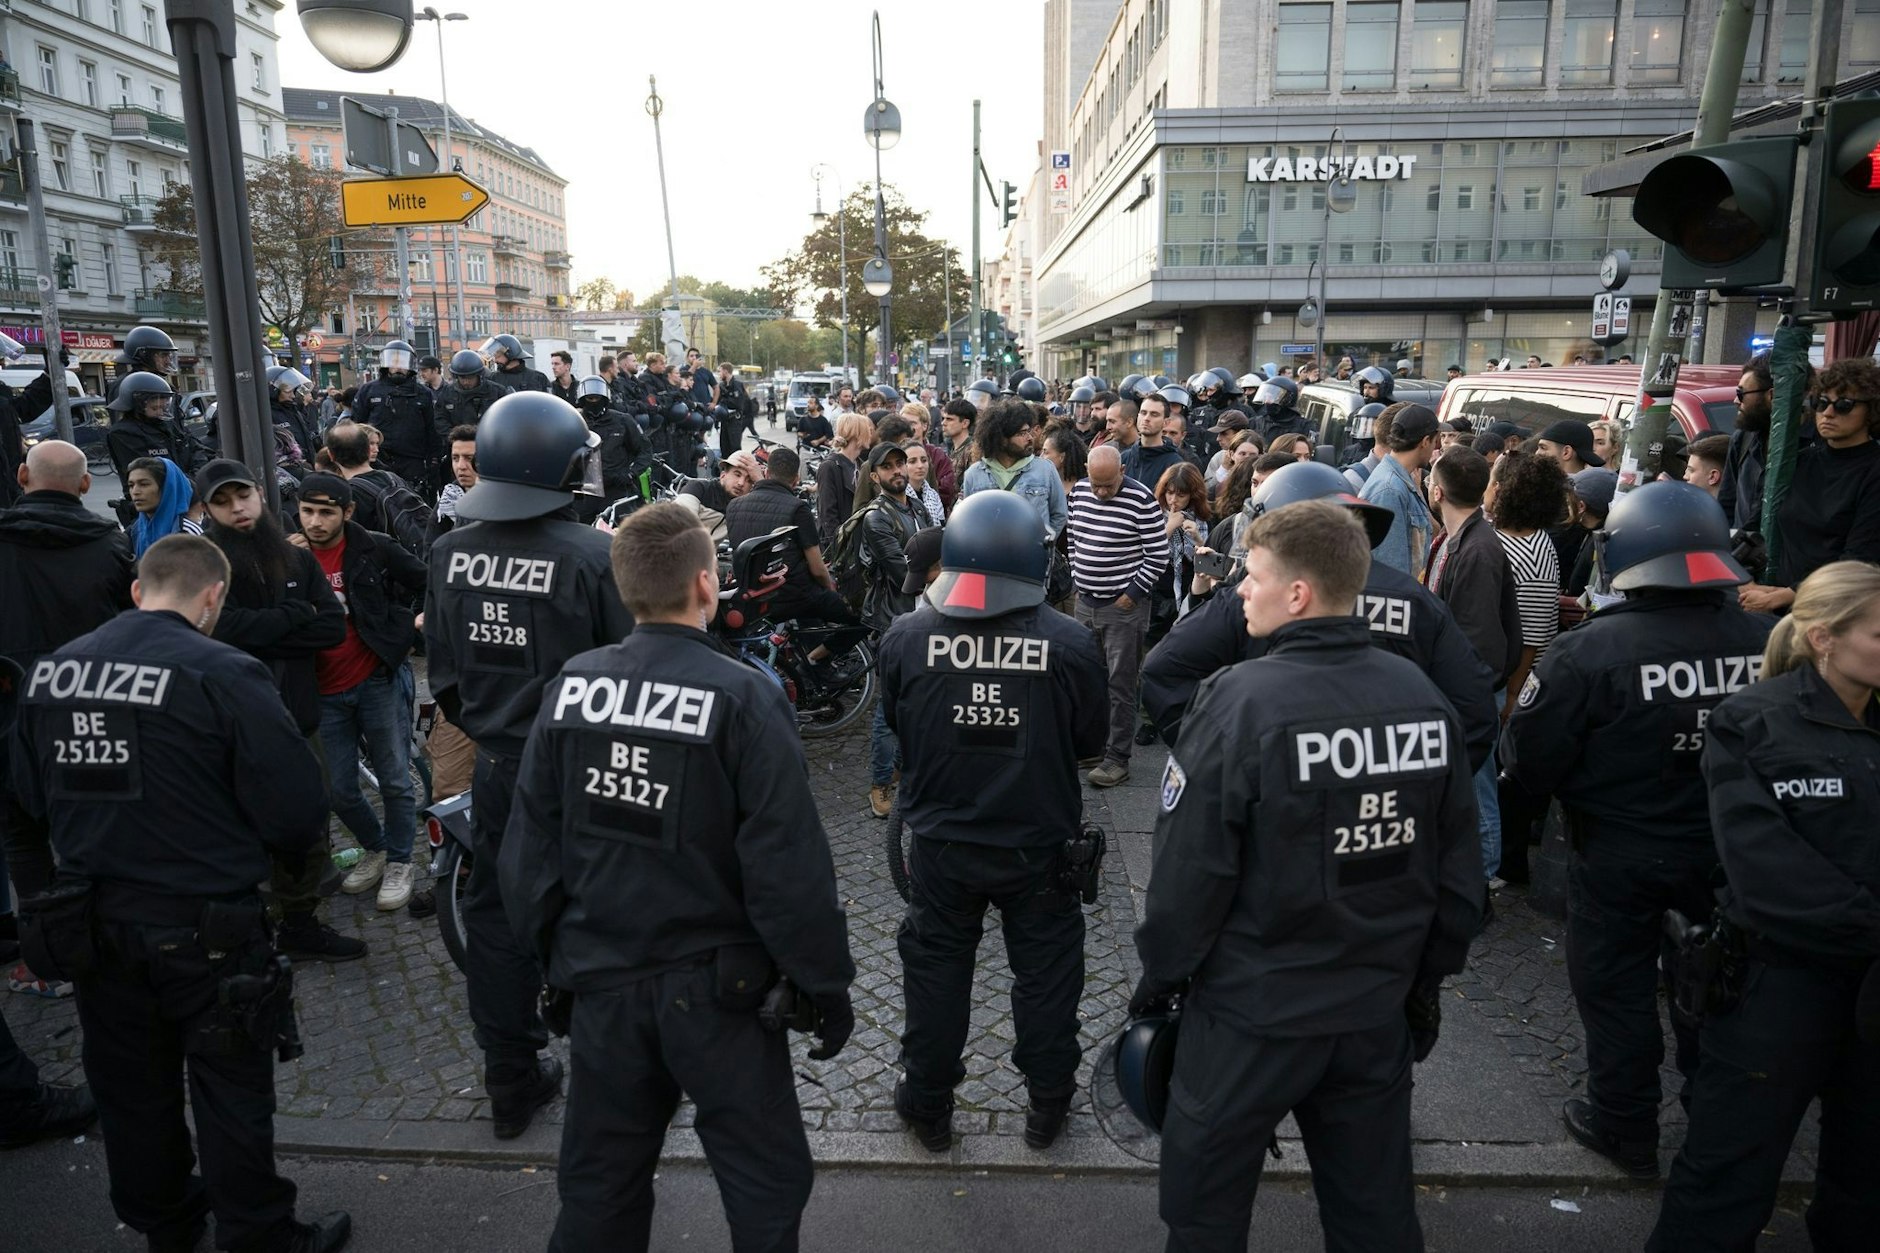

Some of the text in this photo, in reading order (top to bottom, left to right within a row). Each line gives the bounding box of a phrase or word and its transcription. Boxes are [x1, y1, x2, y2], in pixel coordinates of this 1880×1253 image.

[1247, 155, 1417, 182] KARSTADT
[388, 193, 426, 210] Mitte
[1824, 287, 1839, 300] F7
[447, 552, 555, 593] POLIZEI
[483, 602, 509, 623] BE
[1356, 595, 1411, 635] IZEI
[469, 622, 527, 646] 25328
[928, 634, 1049, 671] POLIZEI
[28, 660, 171, 706] POLIZEI
[1640, 655, 1764, 701] POLIZE
[554, 676, 715, 736] POLIZEI
[972, 683, 1001, 703] BE
[72, 712, 106, 735] BE
[953, 705, 1020, 726] 25325
[54, 740, 129, 763] 25125
[611, 741, 649, 774] BE
[1296, 720, 1447, 781] POLIZEI
[585, 767, 669, 810] 25127
[1773, 778, 1843, 799] POLIZEI
[1359, 791, 1397, 819] BE
[1334, 817, 1415, 854] 25128
